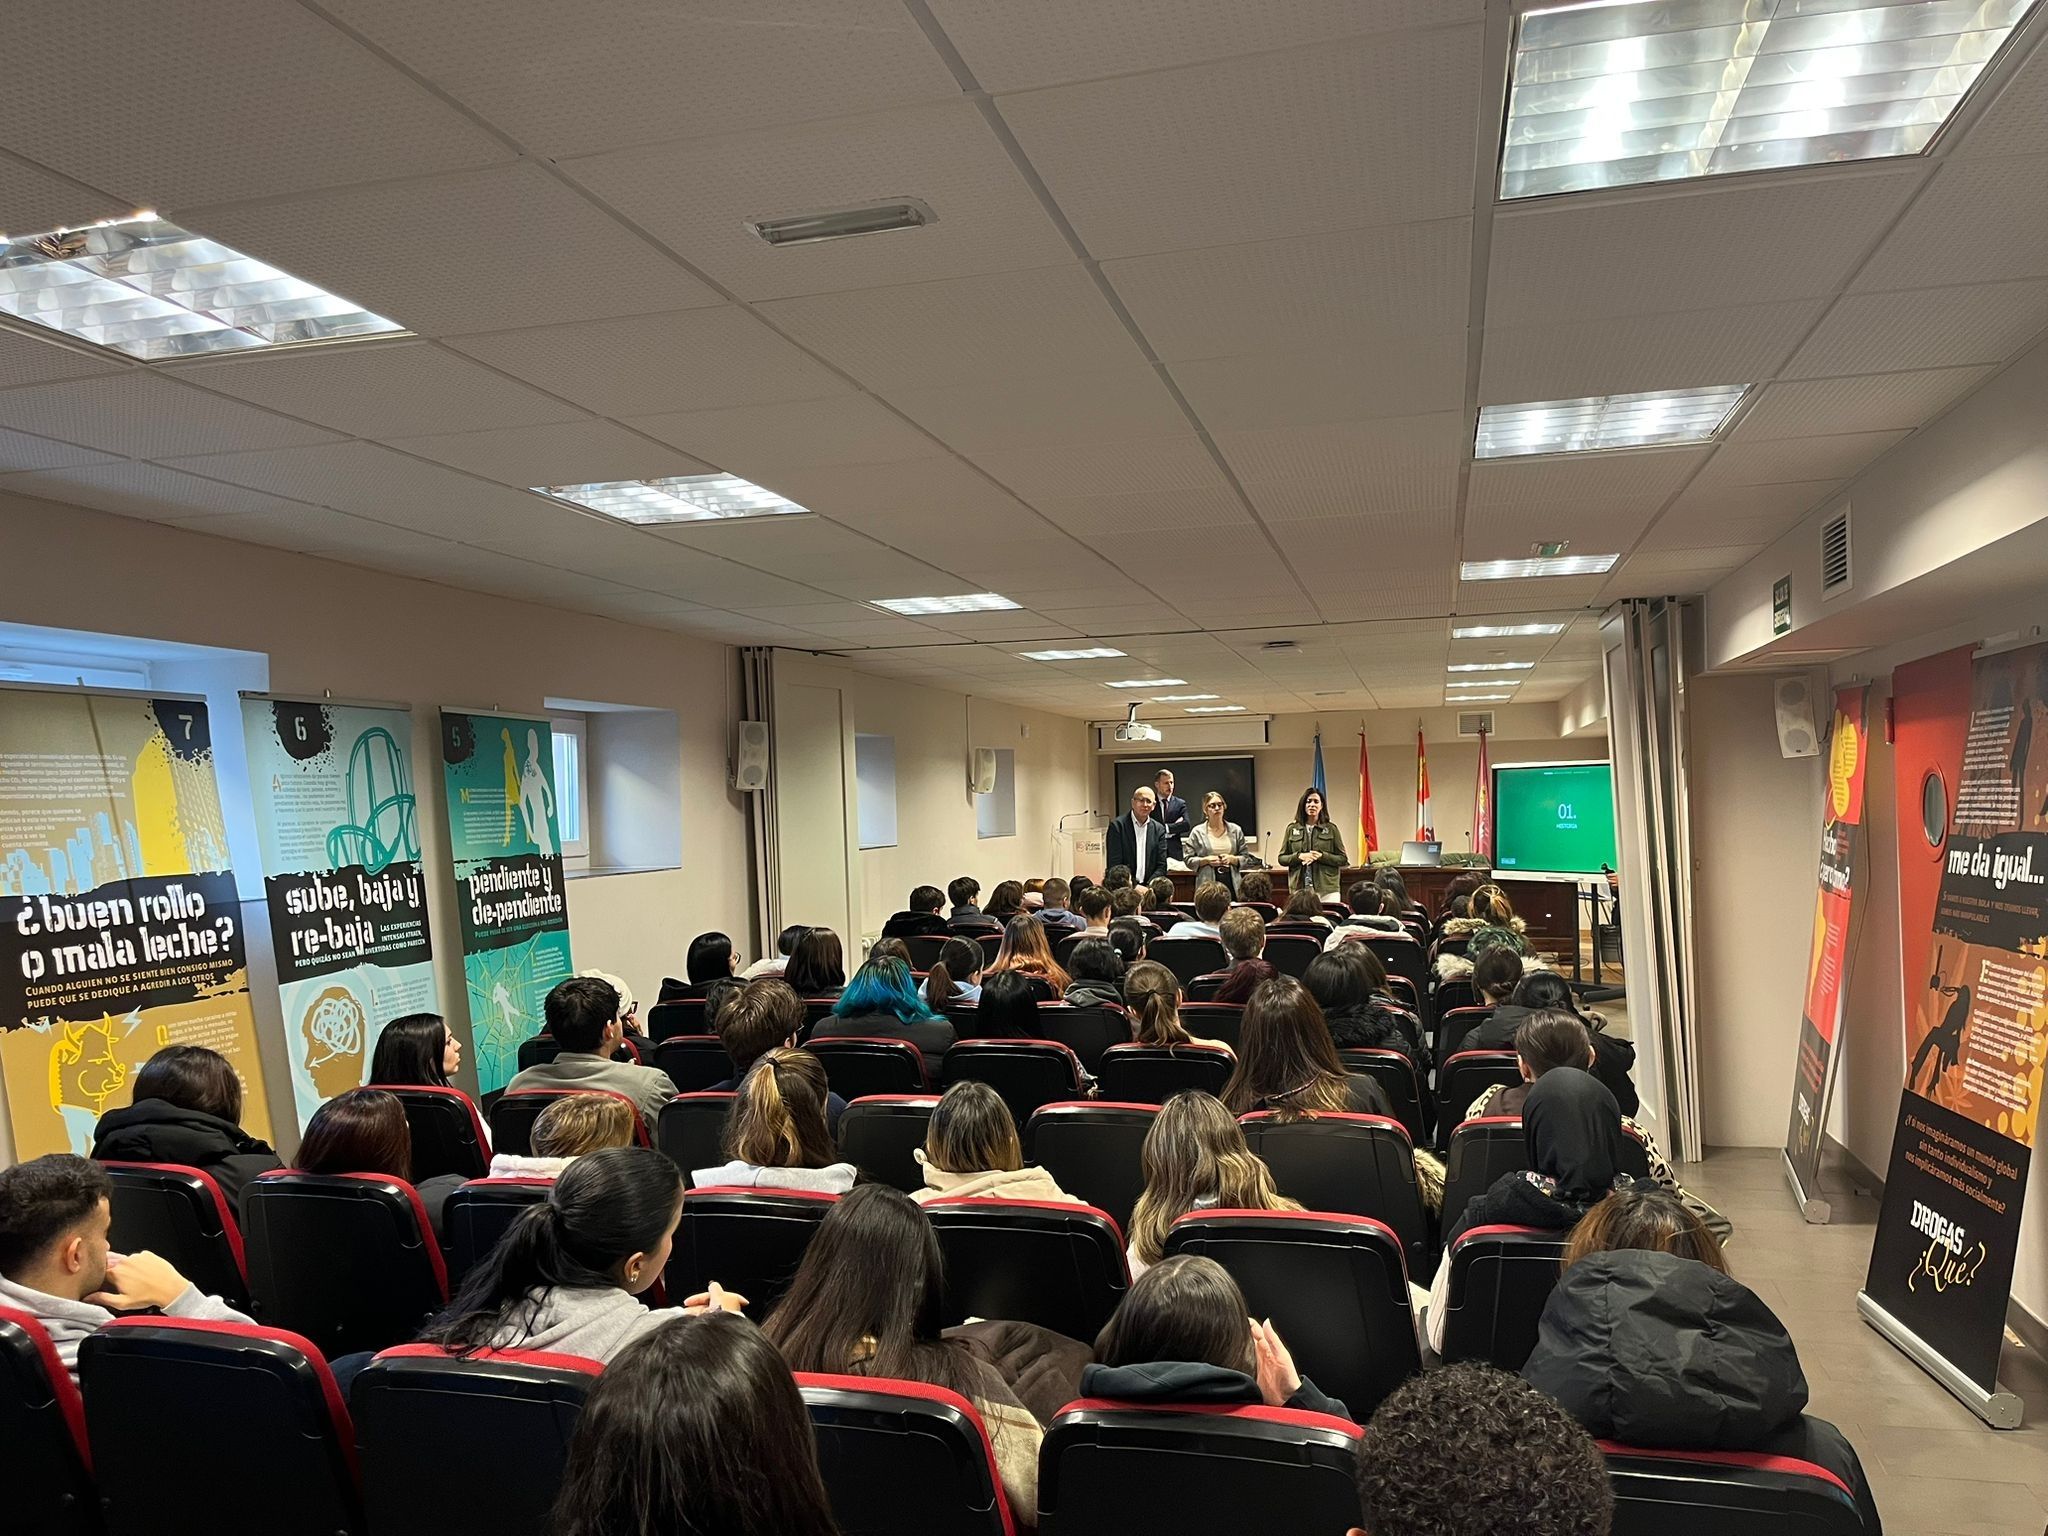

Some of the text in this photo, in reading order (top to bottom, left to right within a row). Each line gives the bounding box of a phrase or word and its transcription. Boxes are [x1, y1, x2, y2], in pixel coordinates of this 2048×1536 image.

[178, 714, 193, 740] 7
[295, 717, 308, 741] 6
[452, 726, 461, 747] 5
[1558, 803, 1577, 819] 01.
[468, 862, 553, 900] pendiente y
[1947, 843, 2044, 889] me da igual...
[17, 883, 206, 936] ¿buen rollo
[285, 873, 421, 916] sube, baja y
[472, 892, 562, 927] de-pendiente
[290, 916, 375, 956] re-baja
[380, 919, 422, 933] LAS EXPERIENCIAS
[382, 932, 405, 942] INTENSAS
[21, 916, 234, 983] o mala leche?
[295, 959, 311, 968] PERO
[311, 955, 332, 967] QUIZÁS
[342, 951, 356, 960] SEAN
[365, 945, 392, 955] DIVERTIDAS
[393, 941, 407, 950] COMO
[407, 938, 426, 948] PARECEN
[25, 958, 234, 997] CUANDO ALGUIEN NO SE SIENTE BIEN CONSIGO MISMO
[27, 972, 215, 1010] PUEDE QUE SE DEDIQUE A AGREDIR A LOS OTROS
[1916, 1120, 1926, 1133] nos
[1925, 1123, 1967, 1153] imagináramos
[1967, 1146, 1975, 1158] un
[1975, 1151, 1997, 1169] mundo
[1996, 1160, 2018, 1180] global
[1919, 1139, 1993, 1189] sin tanto individualismo y
[1905, 1151, 2006, 1214] nos implicáramos más socialmente?
[1910, 1200, 1966, 1255] DROGAS
[1908, 1237, 1986, 1292] ¿Qué?
